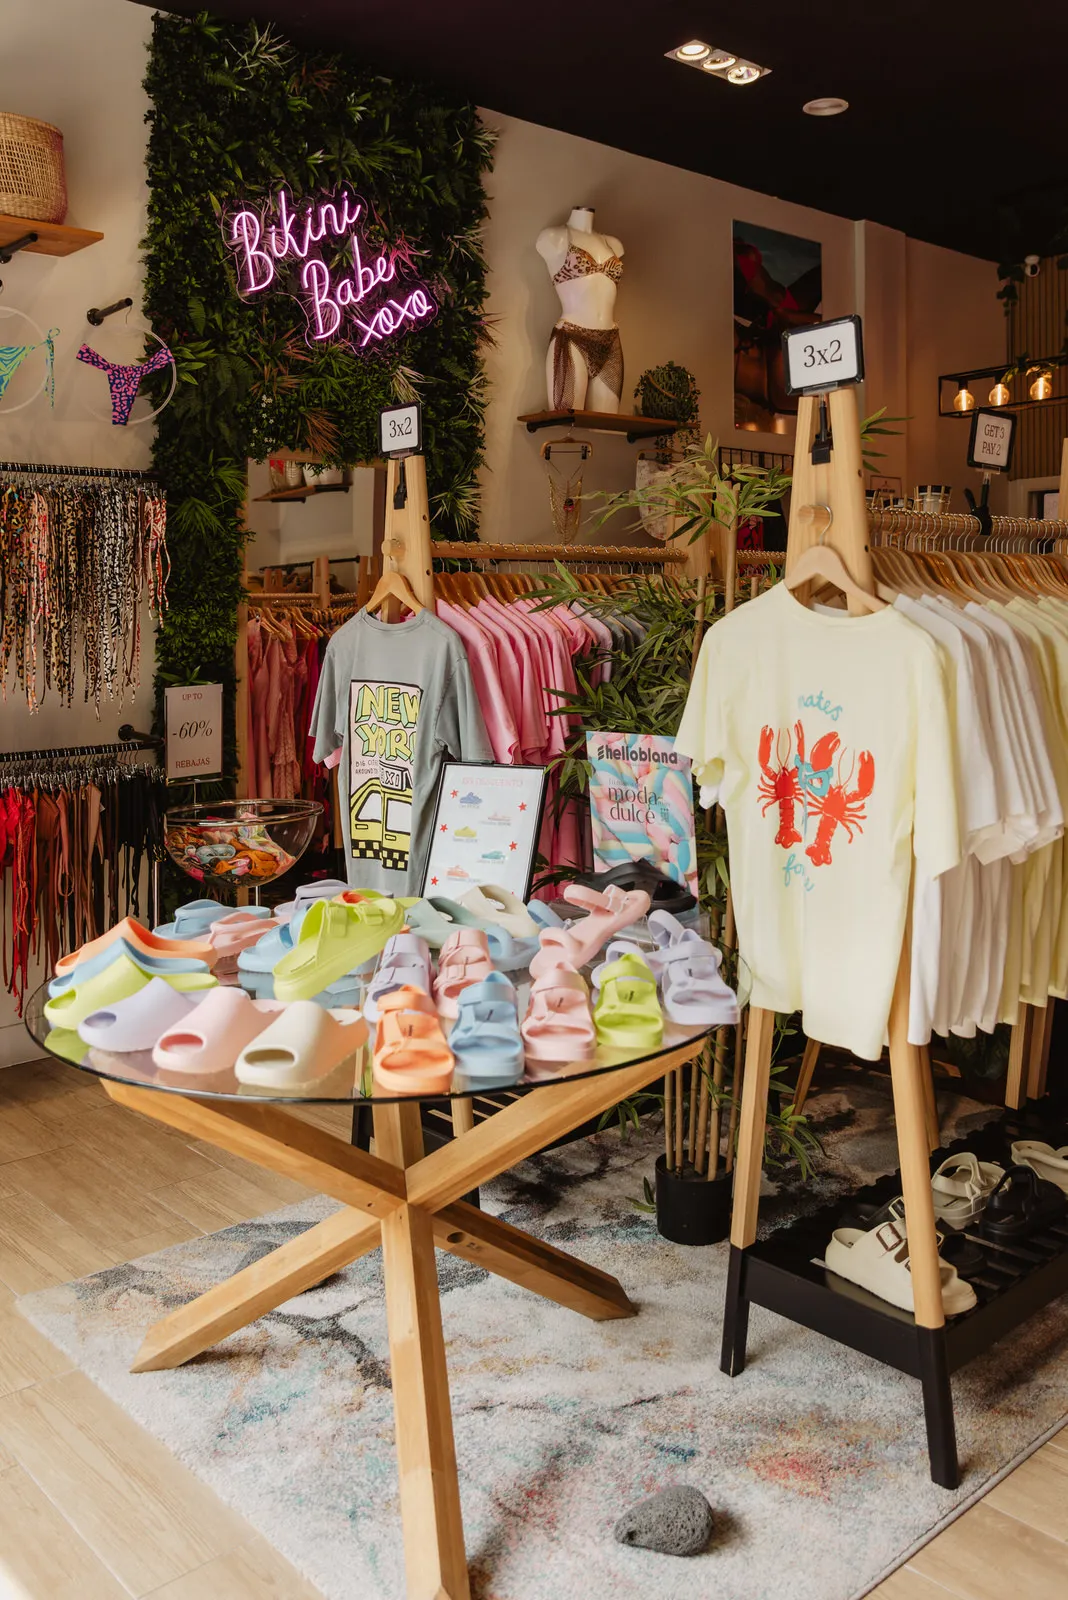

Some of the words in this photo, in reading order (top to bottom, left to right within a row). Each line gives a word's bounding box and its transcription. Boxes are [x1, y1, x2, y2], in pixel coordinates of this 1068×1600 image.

[233, 190, 361, 292] Bikini
[303, 235, 395, 340] Babe
[355, 290, 432, 347] xoxo
[803, 339, 843, 368] 3x2
[389, 416, 413, 438] 3x2
[984, 424, 1000, 438] GET
[1000, 427, 1005, 439] 3
[982, 441, 996, 455] PAY
[996, 444, 1001, 456] 2
[193, 692, 203, 700] TO
[172, 720, 213, 739] -60%
[355, 723, 416, 766] YOR
[175, 757, 211, 769] REBAJAS
[608, 786, 658, 806] moda
